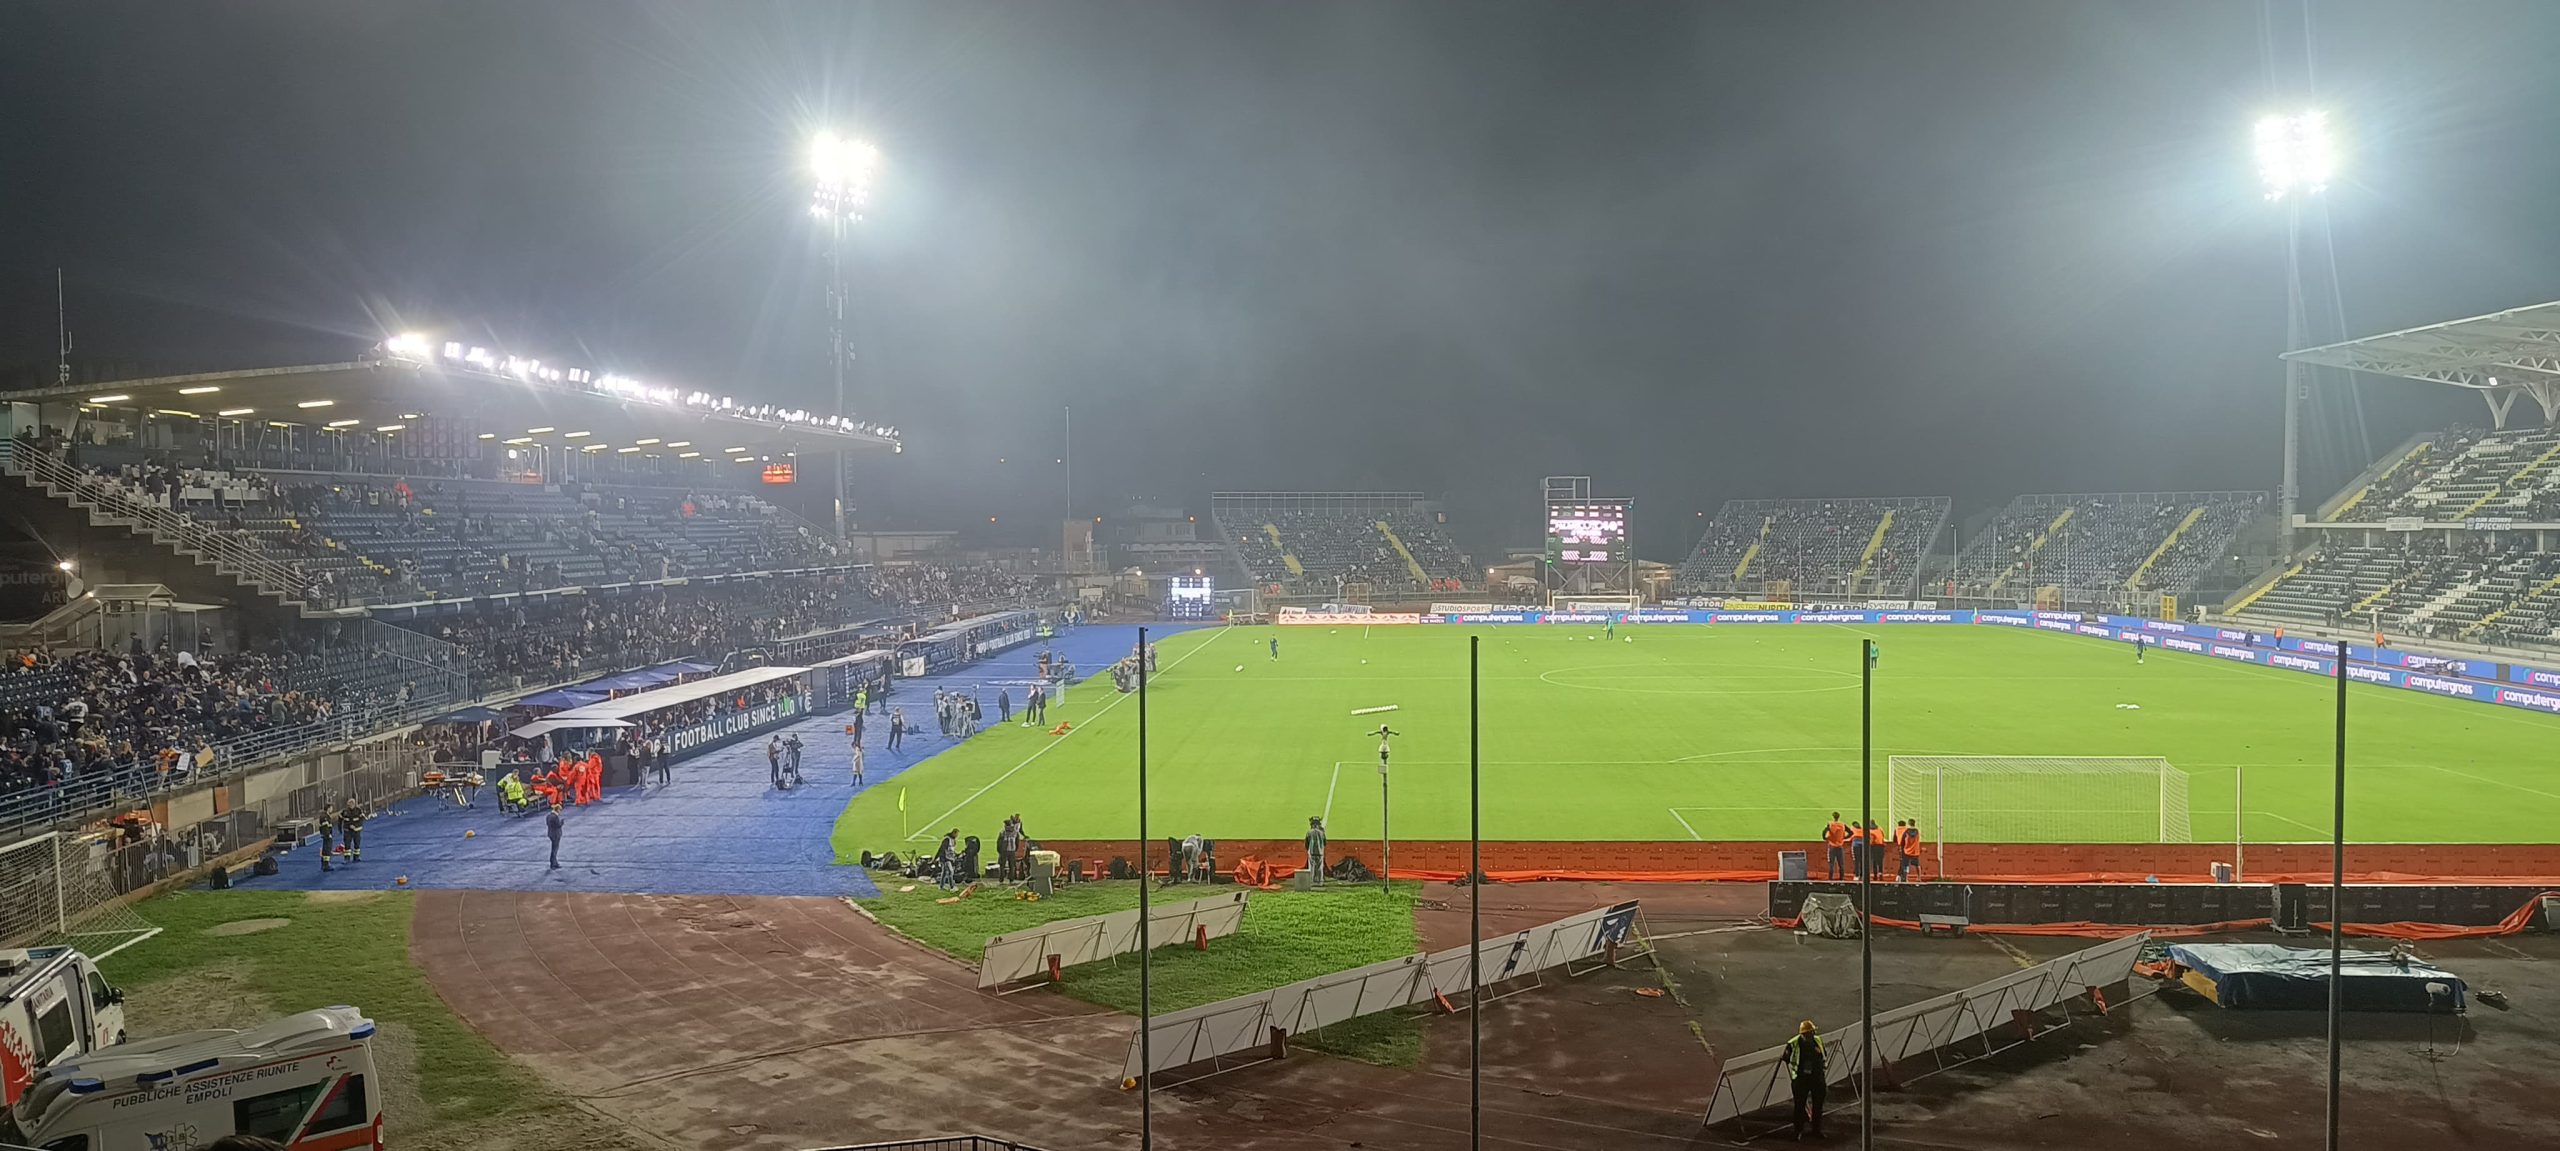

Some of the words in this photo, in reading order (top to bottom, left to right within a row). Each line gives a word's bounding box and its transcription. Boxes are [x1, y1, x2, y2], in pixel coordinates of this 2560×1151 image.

[1463, 614, 1523, 623] computergross
[1717, 614, 1779, 623] computergross
[1800, 613, 1864, 622] computergross
[1887, 613, 1951, 622] computergross
[2273, 655, 2320, 671] computergross
[2410, 675, 2473, 695] computergross
[674, 722, 724, 751] FOOTBALL
[726, 713, 749, 734] CLUB
[751, 704, 776, 726] SINCE
[113, 1085, 181, 1109] PUBBLICHE
[184, 1071, 254, 1094] ASSISTENZE
[256, 1062, 300, 1079] RIUNITE
[186, 1087, 233, 1105] EMPOLI
